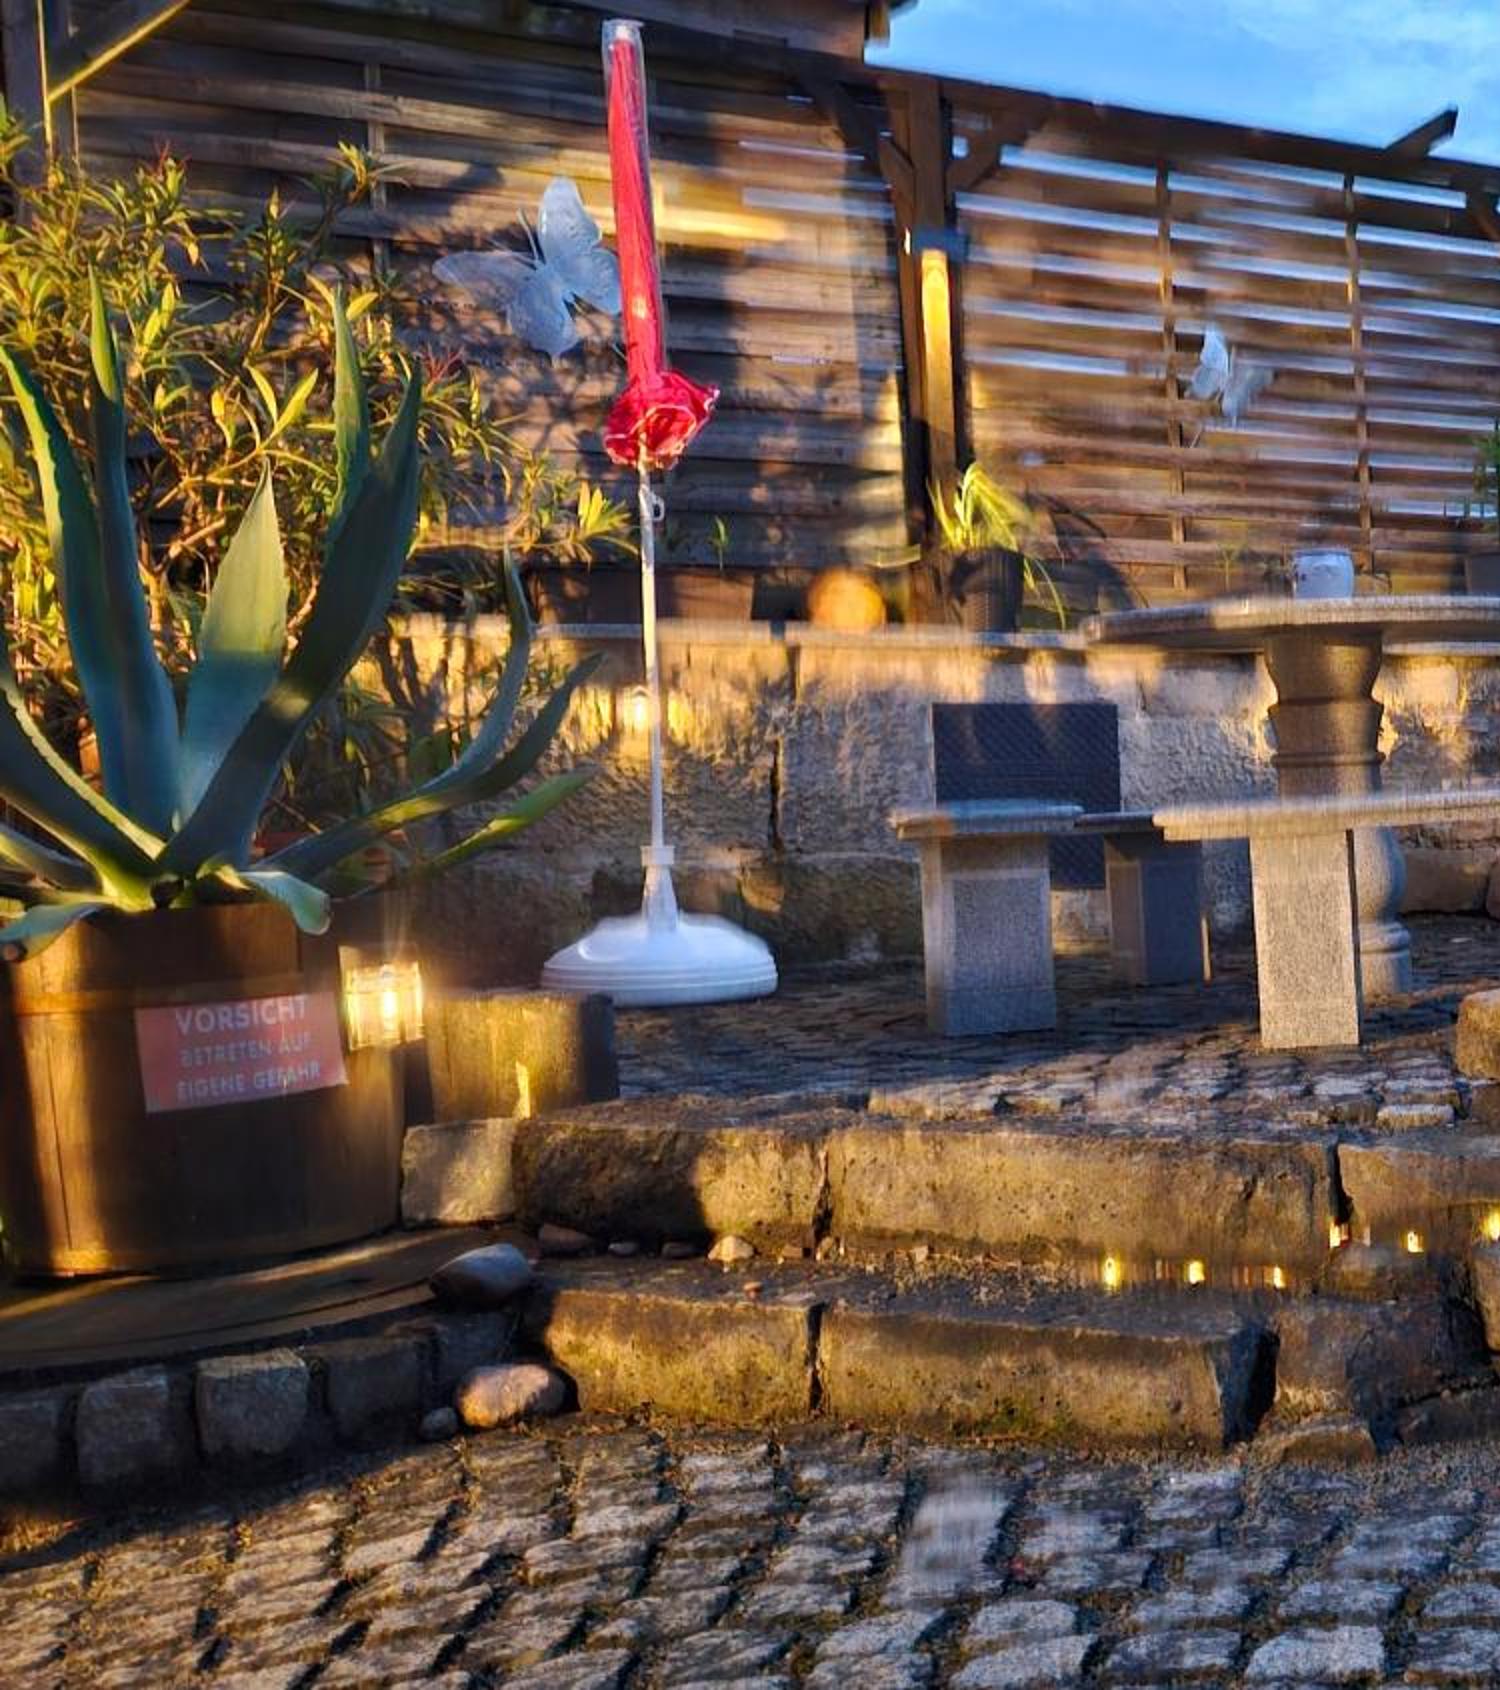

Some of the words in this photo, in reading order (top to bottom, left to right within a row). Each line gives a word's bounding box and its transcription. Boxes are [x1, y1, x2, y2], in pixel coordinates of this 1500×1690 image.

[176, 995, 307, 1035] VORSICHT
[181, 1039, 272, 1067] BETRETEN
[278, 1032, 311, 1054] AUF
[177, 1073, 245, 1098] EIGENE
[253, 1061, 321, 1089] GEFAHR
